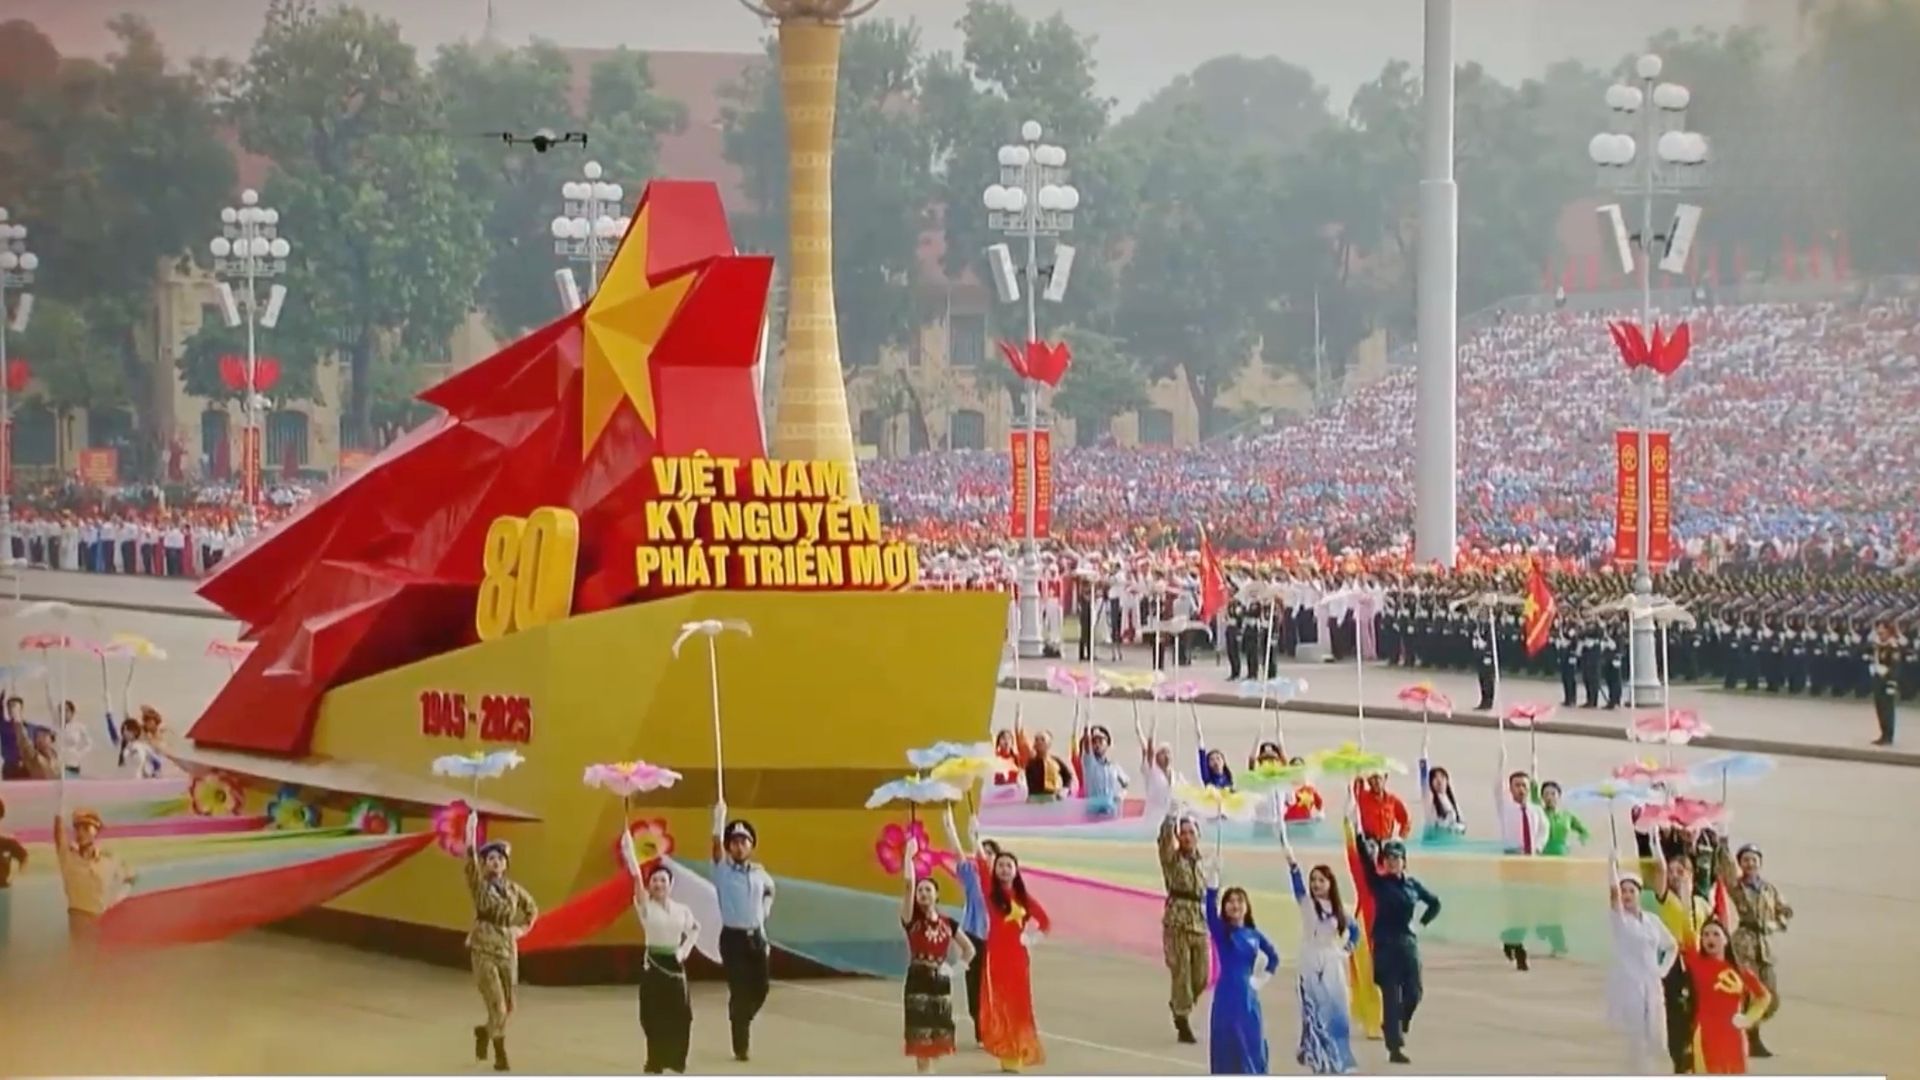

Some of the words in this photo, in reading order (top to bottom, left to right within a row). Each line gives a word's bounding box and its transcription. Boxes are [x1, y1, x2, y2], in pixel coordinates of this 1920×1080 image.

[652, 449, 741, 504] VIỆT
[751, 458, 847, 498] NAM
[711, 496, 882, 541] NGUYÊN
[476, 506, 580, 642] 80
[636, 538, 730, 587] PHÁT
[738, 535, 844, 586] TRIỂN
[850, 540, 919, 588] MỚI
